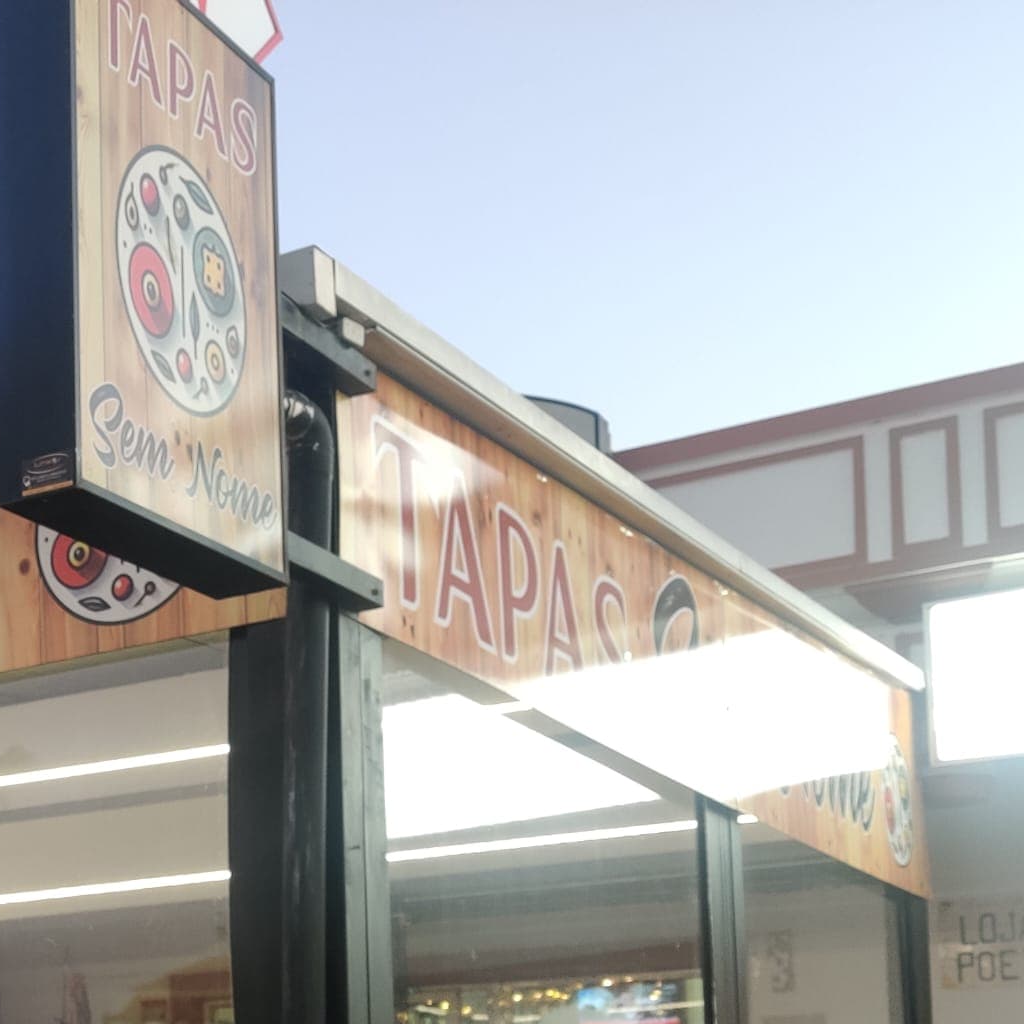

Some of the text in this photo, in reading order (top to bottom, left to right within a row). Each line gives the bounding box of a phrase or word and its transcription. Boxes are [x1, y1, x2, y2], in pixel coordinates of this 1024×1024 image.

[109, 0, 257, 176] TAPAS
[88, 383, 277, 530] Sem Nome
